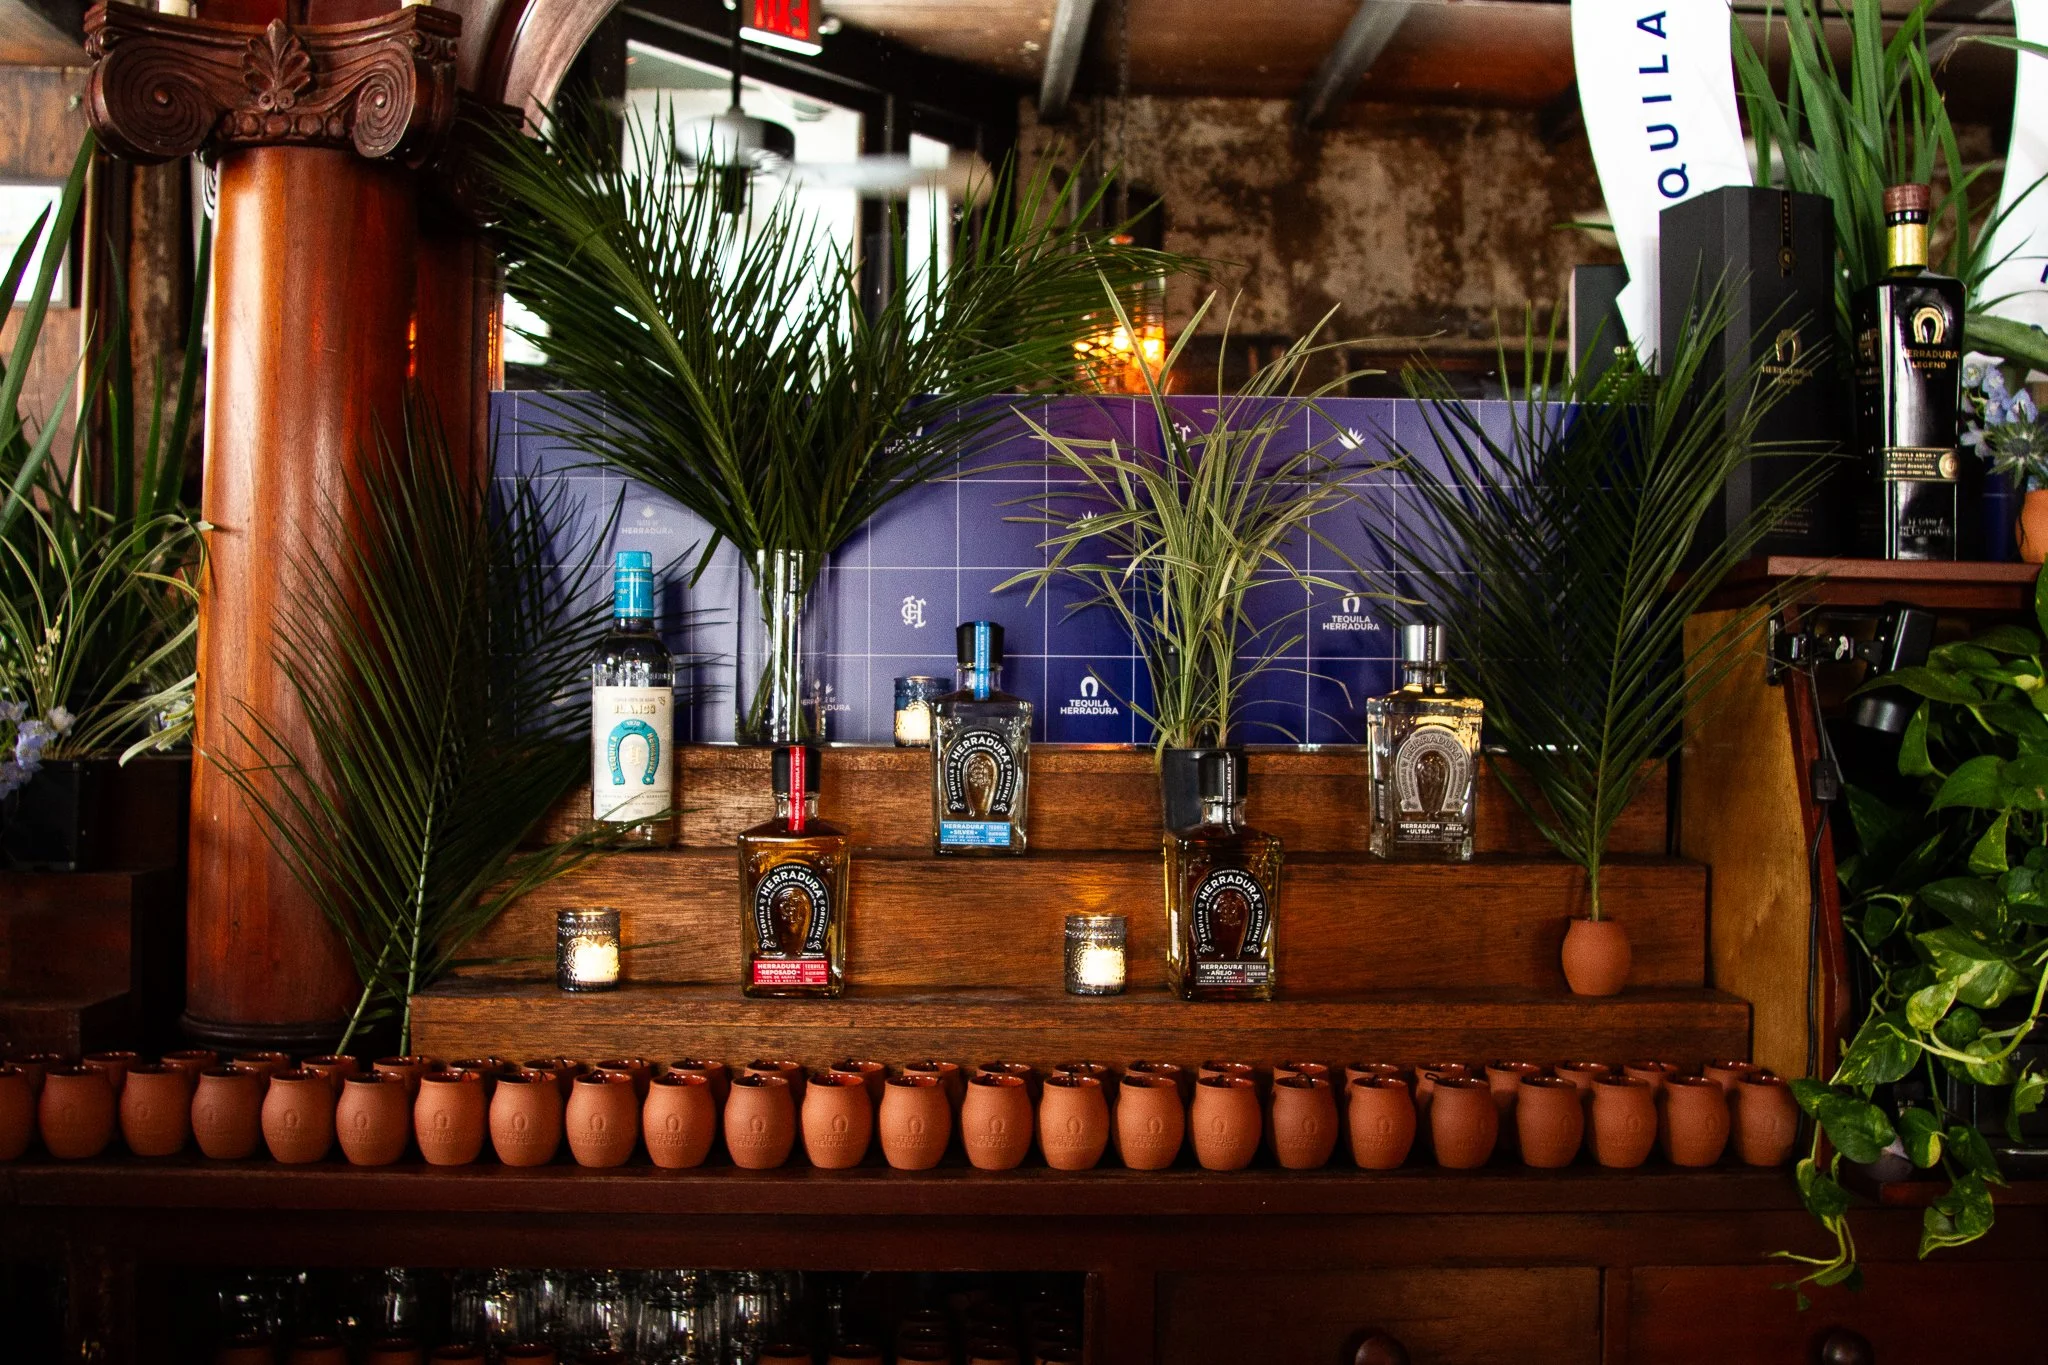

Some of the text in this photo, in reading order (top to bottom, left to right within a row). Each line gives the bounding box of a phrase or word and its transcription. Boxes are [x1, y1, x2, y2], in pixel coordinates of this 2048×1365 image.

[1637, 10, 1690, 199] QUILA
[1911, 361, 1947, 369] LEGEND
[1322, 623, 1380, 631] HERRADURA
[1331, 615, 1371, 623] TEQUILA
[1060, 707, 1119, 715] HERRADURA
[1069, 700, 1110, 708] TEQUILA
[609, 736, 619, 772] TEQUILA
[951, 736, 1012, 763] HERRADURA
[1403, 735, 1462, 761] HERRADURA
[949, 769, 959, 799] TEQUILA
[1000, 771, 1012, 801] ORIGINAL
[760, 871, 824, 898] HERRADURA
[1199, 875, 1261, 902] HERRADURA
[759, 906, 769, 938] TEQUILA
[814, 906, 826, 939] ORIGINAL
[1197, 910, 1207, 942] TEQUILA
[1251, 910, 1263, 942] ORIGINAL
